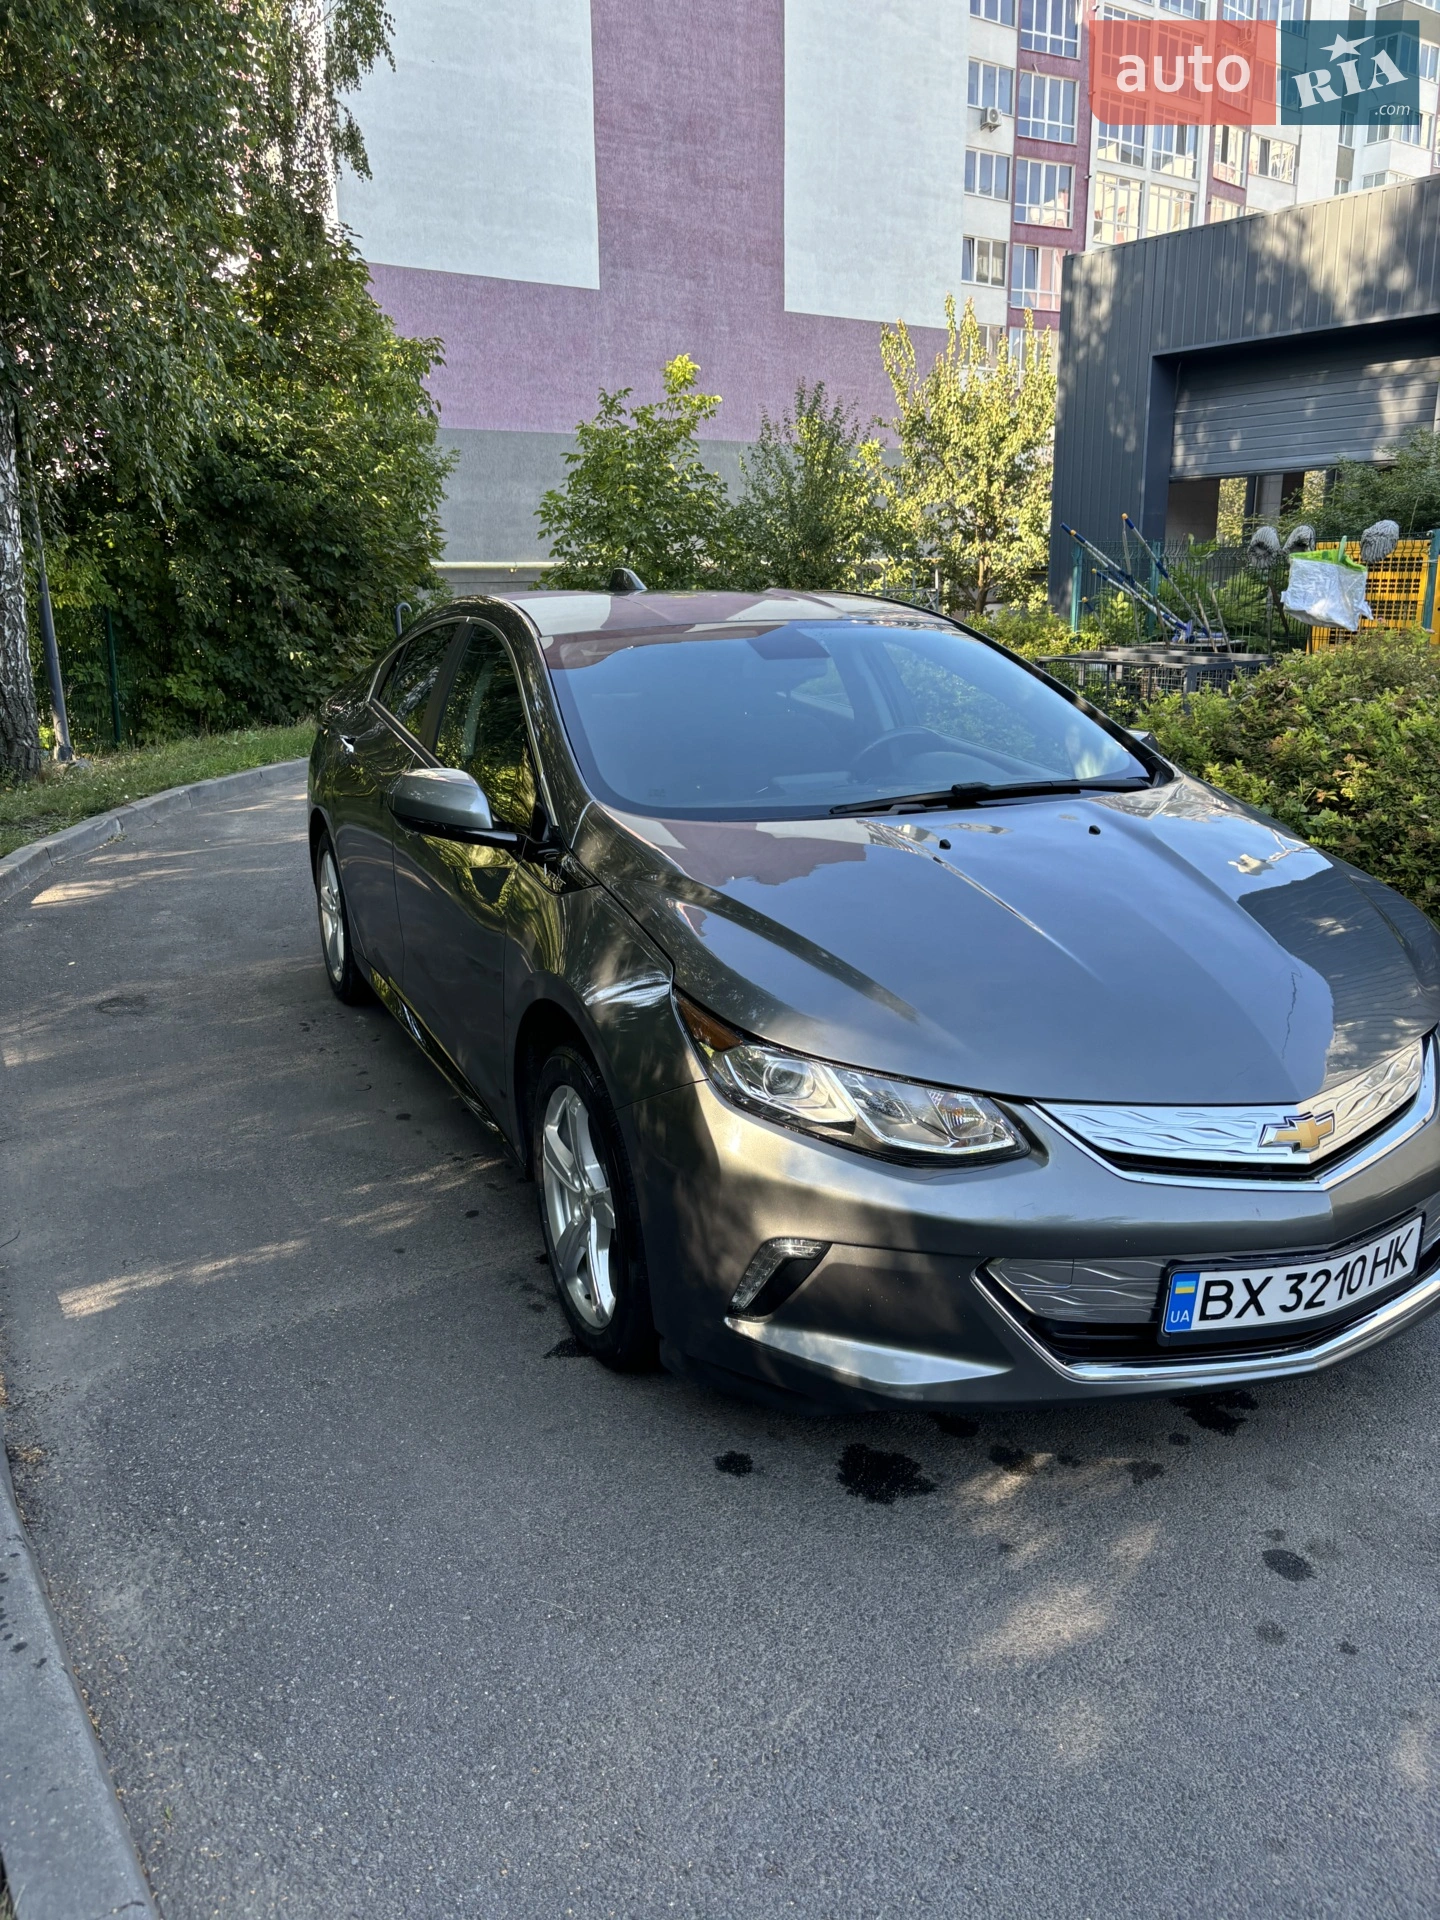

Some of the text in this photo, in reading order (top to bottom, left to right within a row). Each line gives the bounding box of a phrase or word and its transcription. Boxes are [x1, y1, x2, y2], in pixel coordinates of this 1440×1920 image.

[1199, 1227, 1414, 1321] BX 3210 HK
[1170, 1310, 1190, 1323] UA
